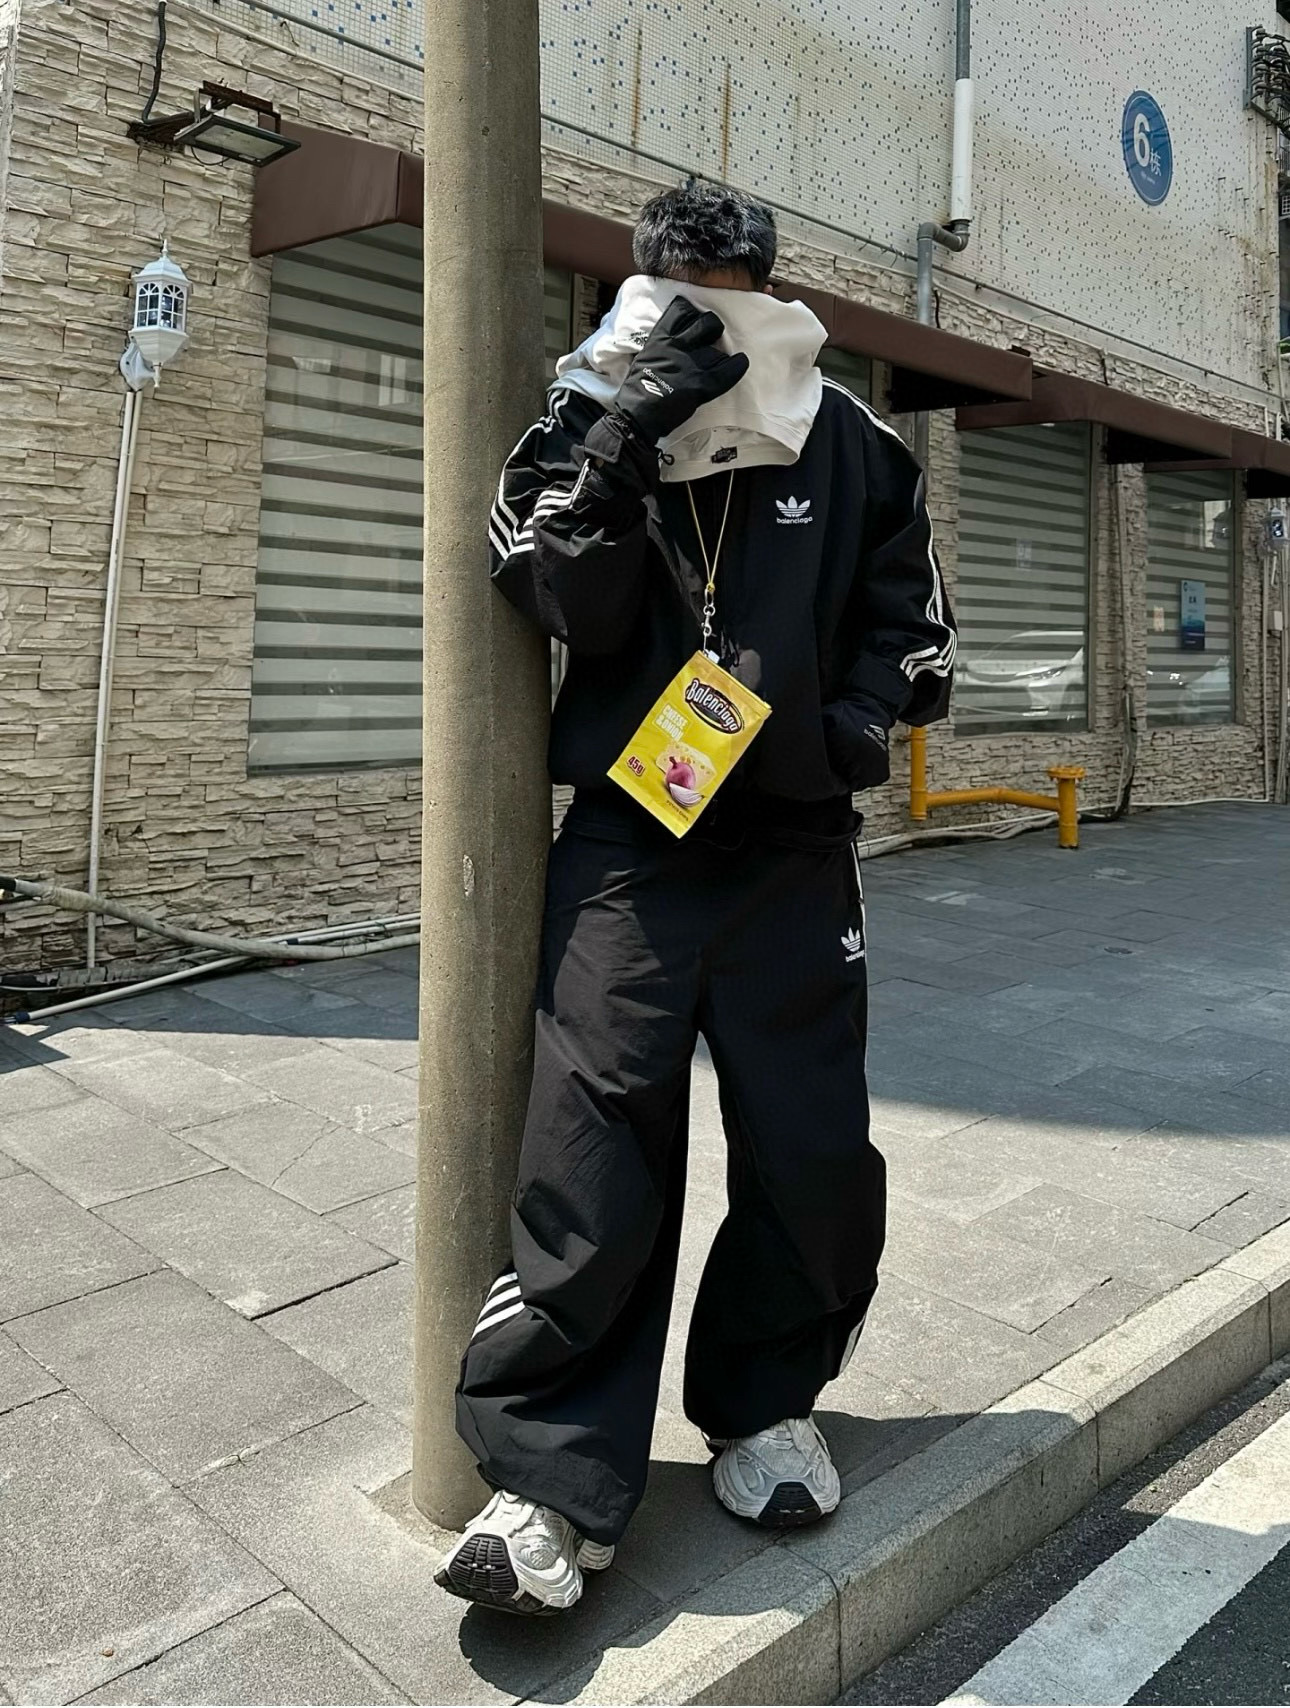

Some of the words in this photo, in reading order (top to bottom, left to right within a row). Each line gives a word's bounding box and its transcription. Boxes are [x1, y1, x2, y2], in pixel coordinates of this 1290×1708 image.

[663, 704, 688, 730] CHEESE
[686, 678, 740, 732] Balenciaga
[661, 719, 684, 741] ONION
[627, 755, 645, 775] 45g
